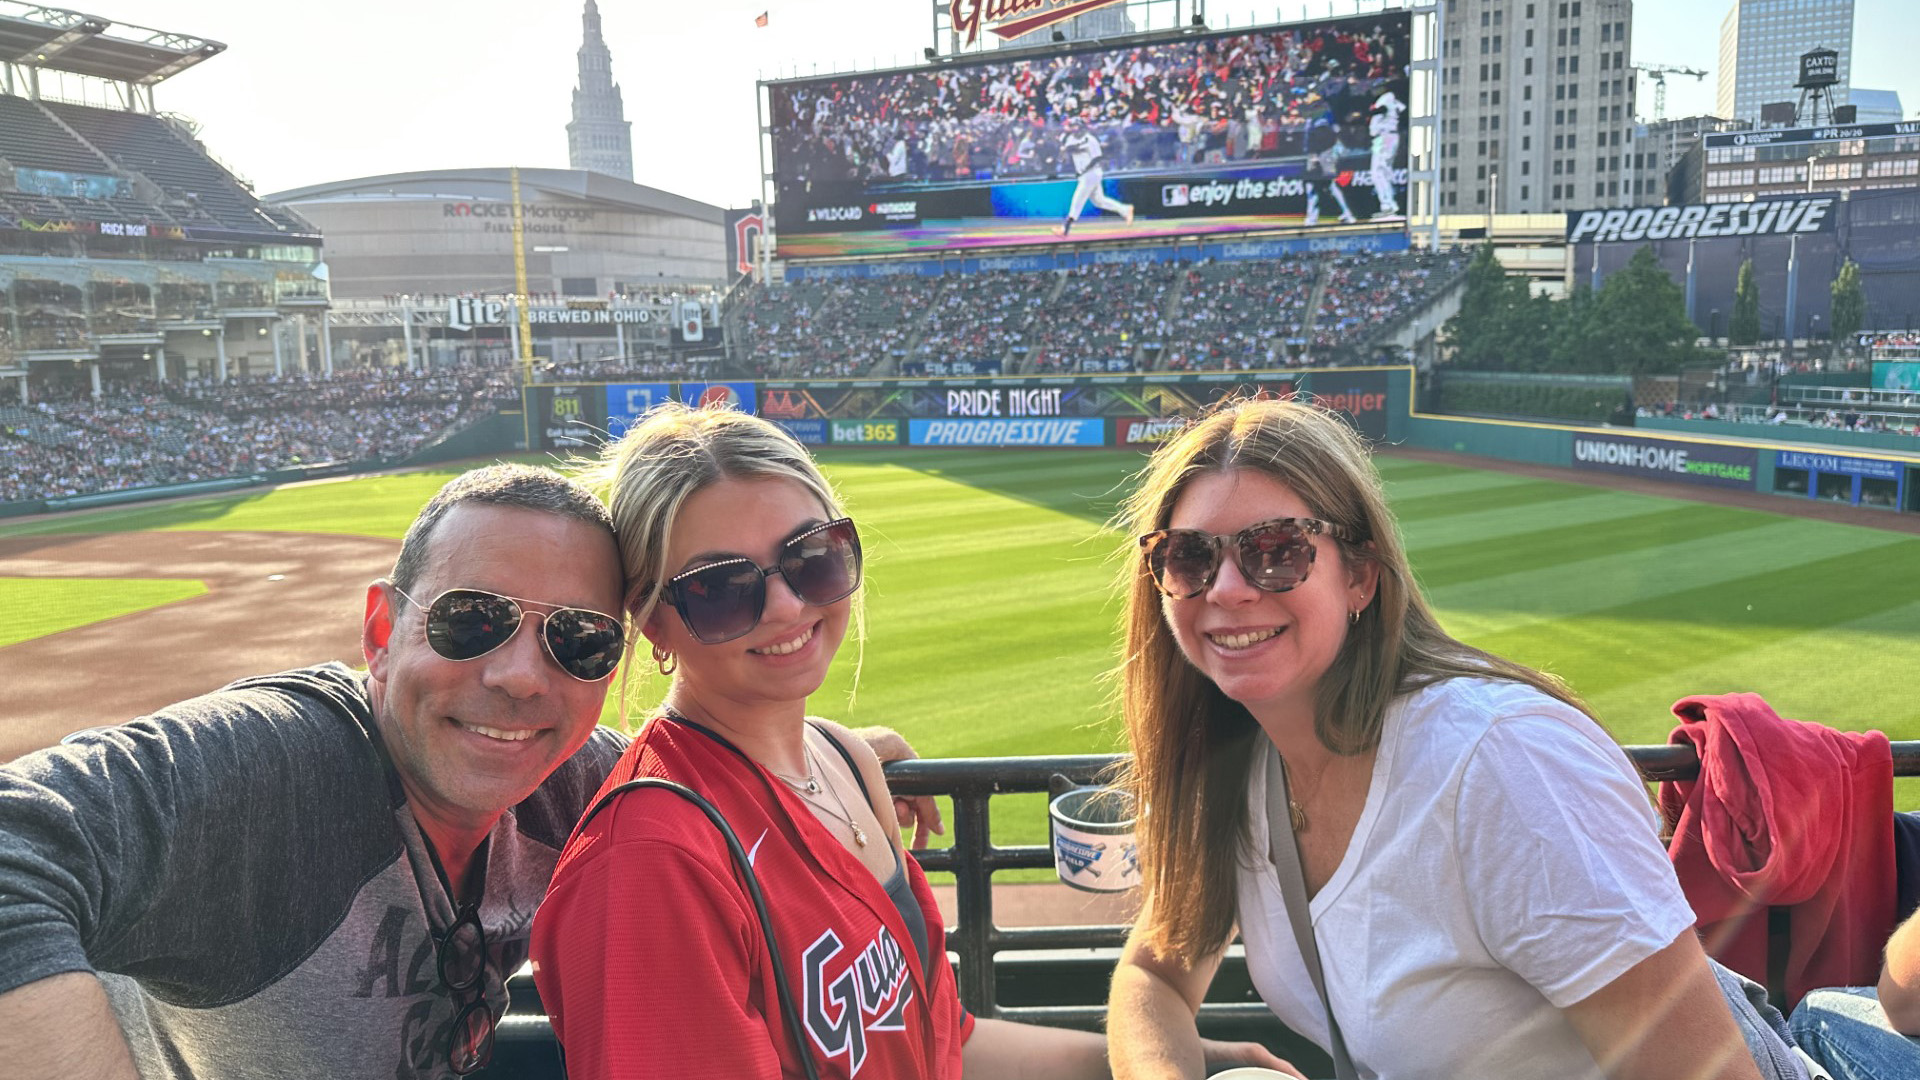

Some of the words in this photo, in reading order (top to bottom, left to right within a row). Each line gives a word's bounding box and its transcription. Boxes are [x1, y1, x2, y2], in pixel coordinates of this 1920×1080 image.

[1805, 55, 1836, 68] CAXTO
[1823, 130, 1838, 139] PR
[1189, 181, 1233, 205] enjoy
[1236, 177, 1263, 200] the
[443, 202, 514, 217] ROCKET
[522, 203, 595, 223] Mortgage
[1569, 198, 1834, 243] PROGRESSIVE
[448, 297, 503, 332] Lite
[529, 311, 590, 324] BREWED
[594, 310, 610, 323] IN
[614, 309, 649, 323] OHIO
[555, 398, 579, 416] 811
[946, 389, 1000, 416] PRIDE
[1009, 388, 1062, 416] NIGHT
[832, 423, 896, 442] bet365
[924, 420, 1085, 444] PROGRESSIVE
[1782, 451, 1838, 472] LECOM
[802, 925, 909, 1079] Gua
